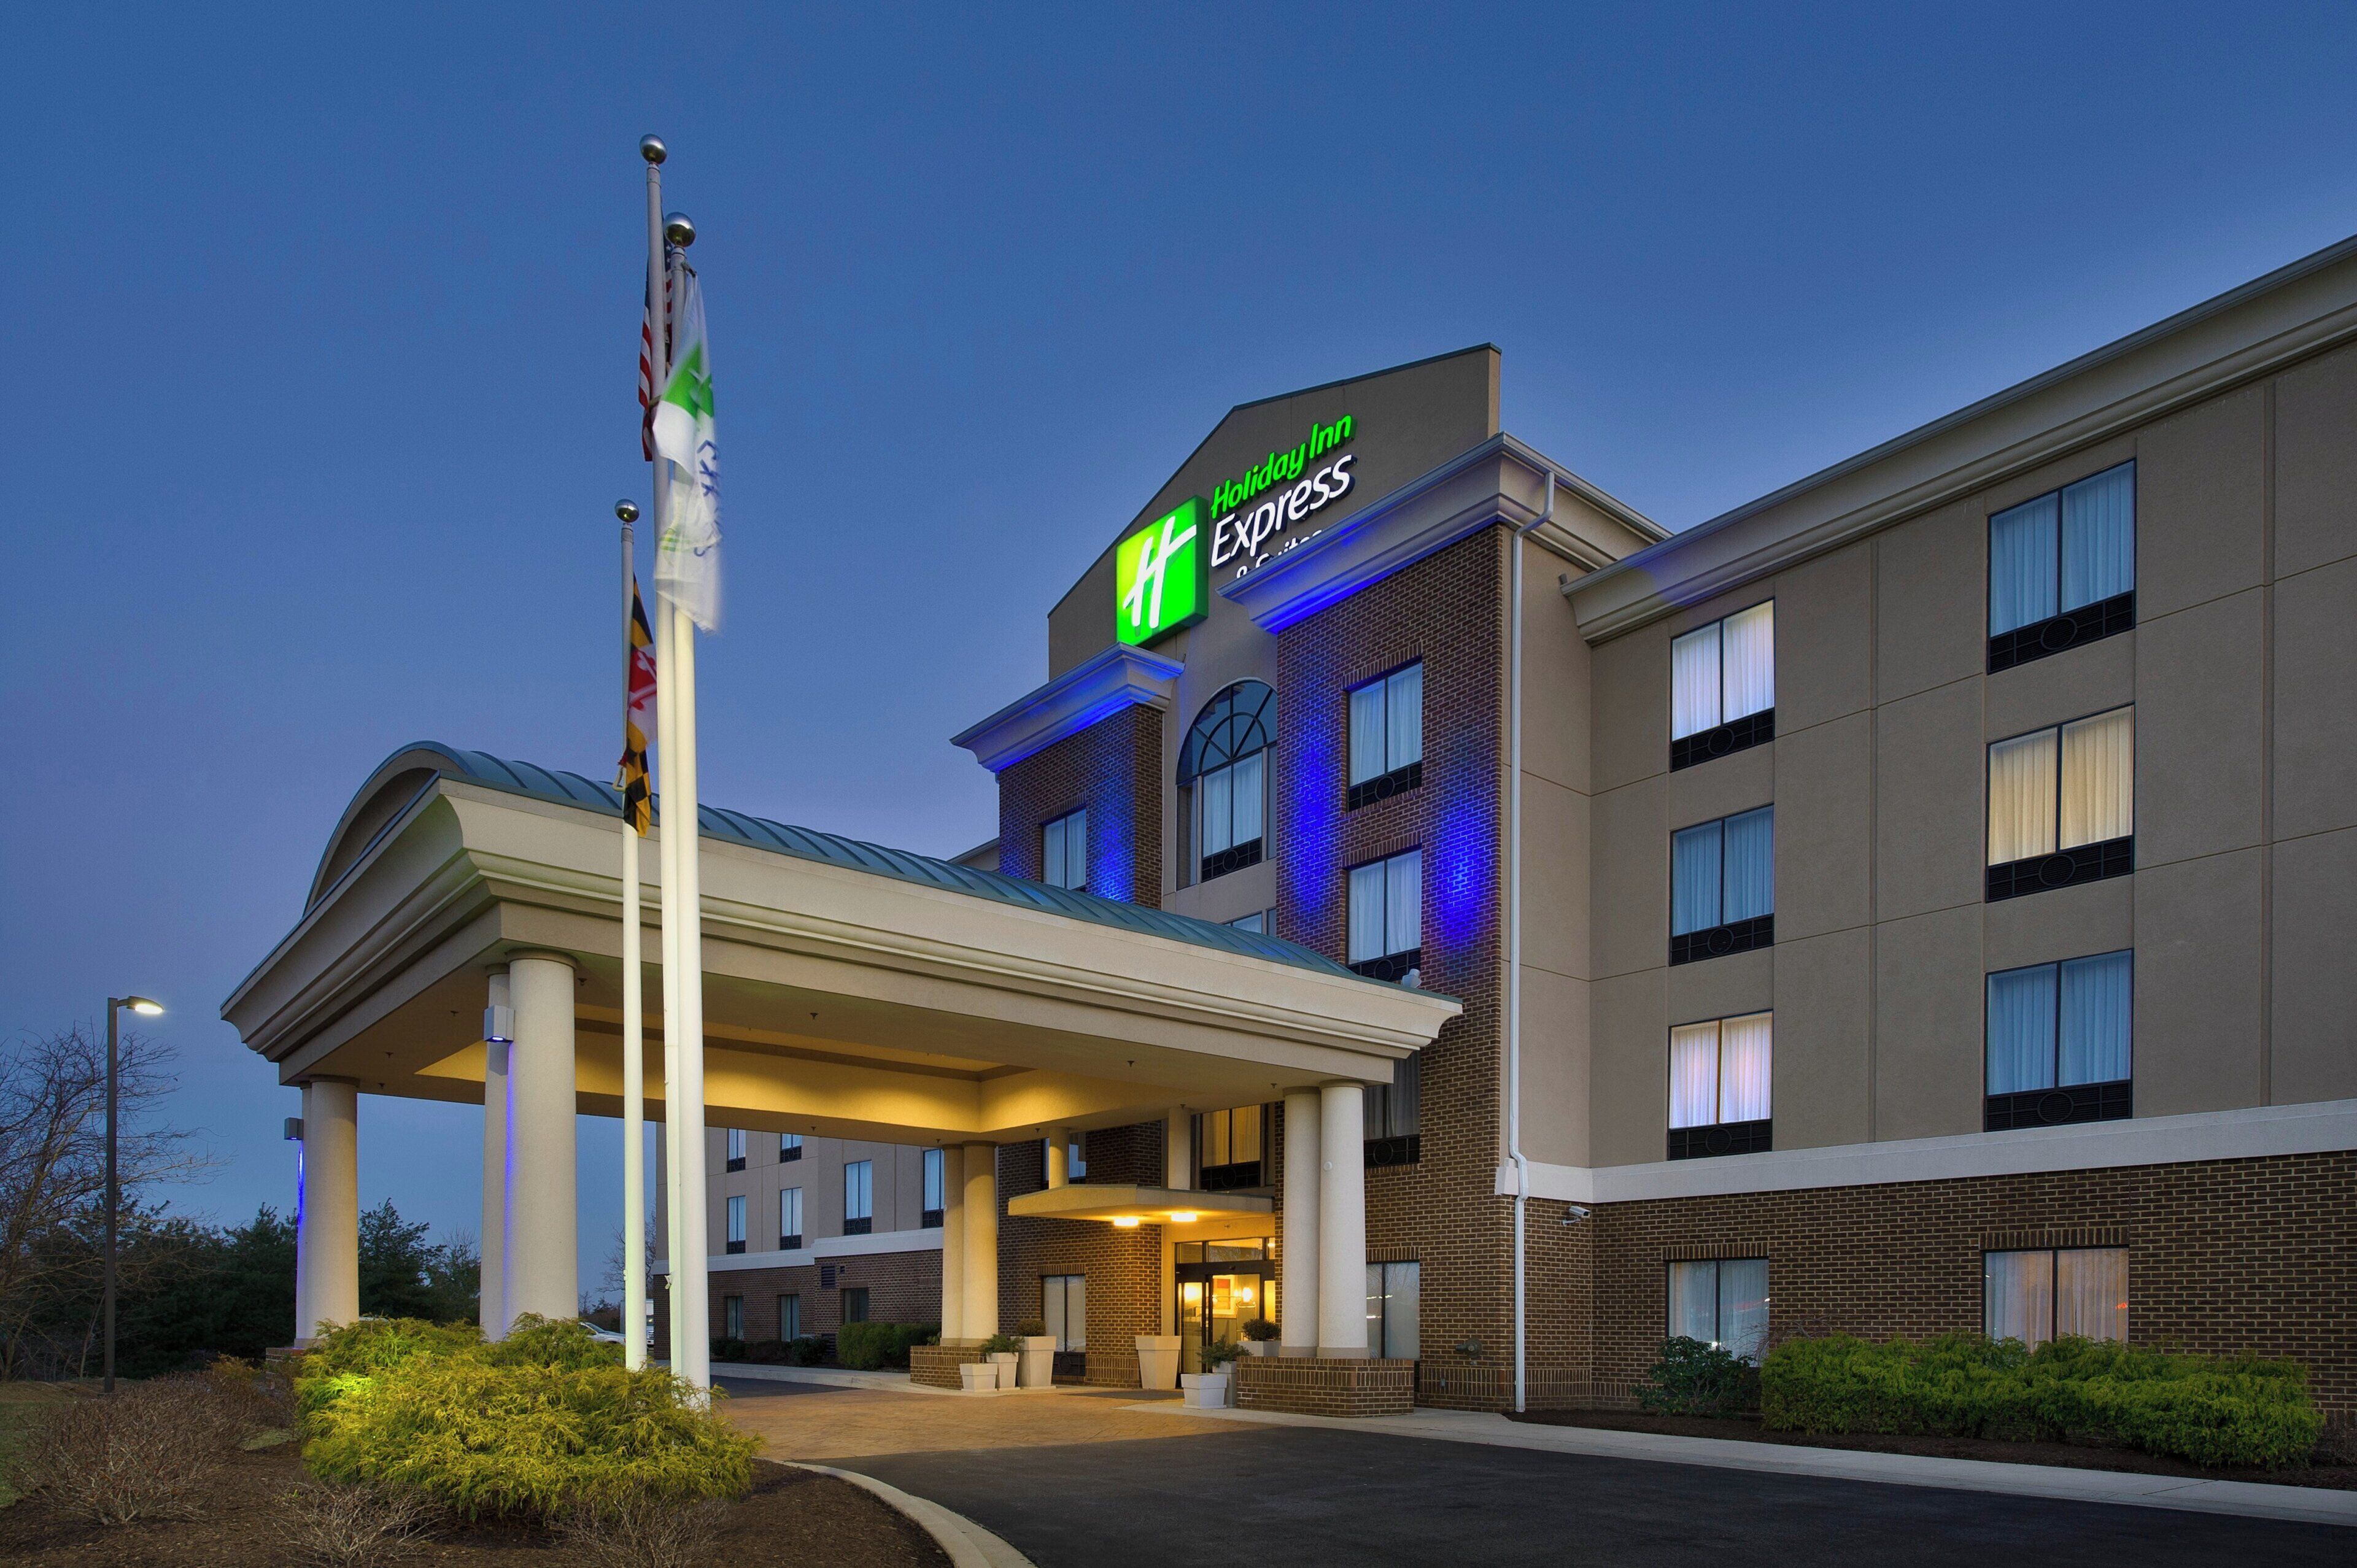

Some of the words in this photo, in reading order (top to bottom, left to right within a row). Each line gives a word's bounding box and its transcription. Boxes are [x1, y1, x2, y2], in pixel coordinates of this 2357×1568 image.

[1210, 442, 1306, 519] Holiday
[1309, 414, 1352, 459] Inn
[1210, 454, 1353, 567] Express
